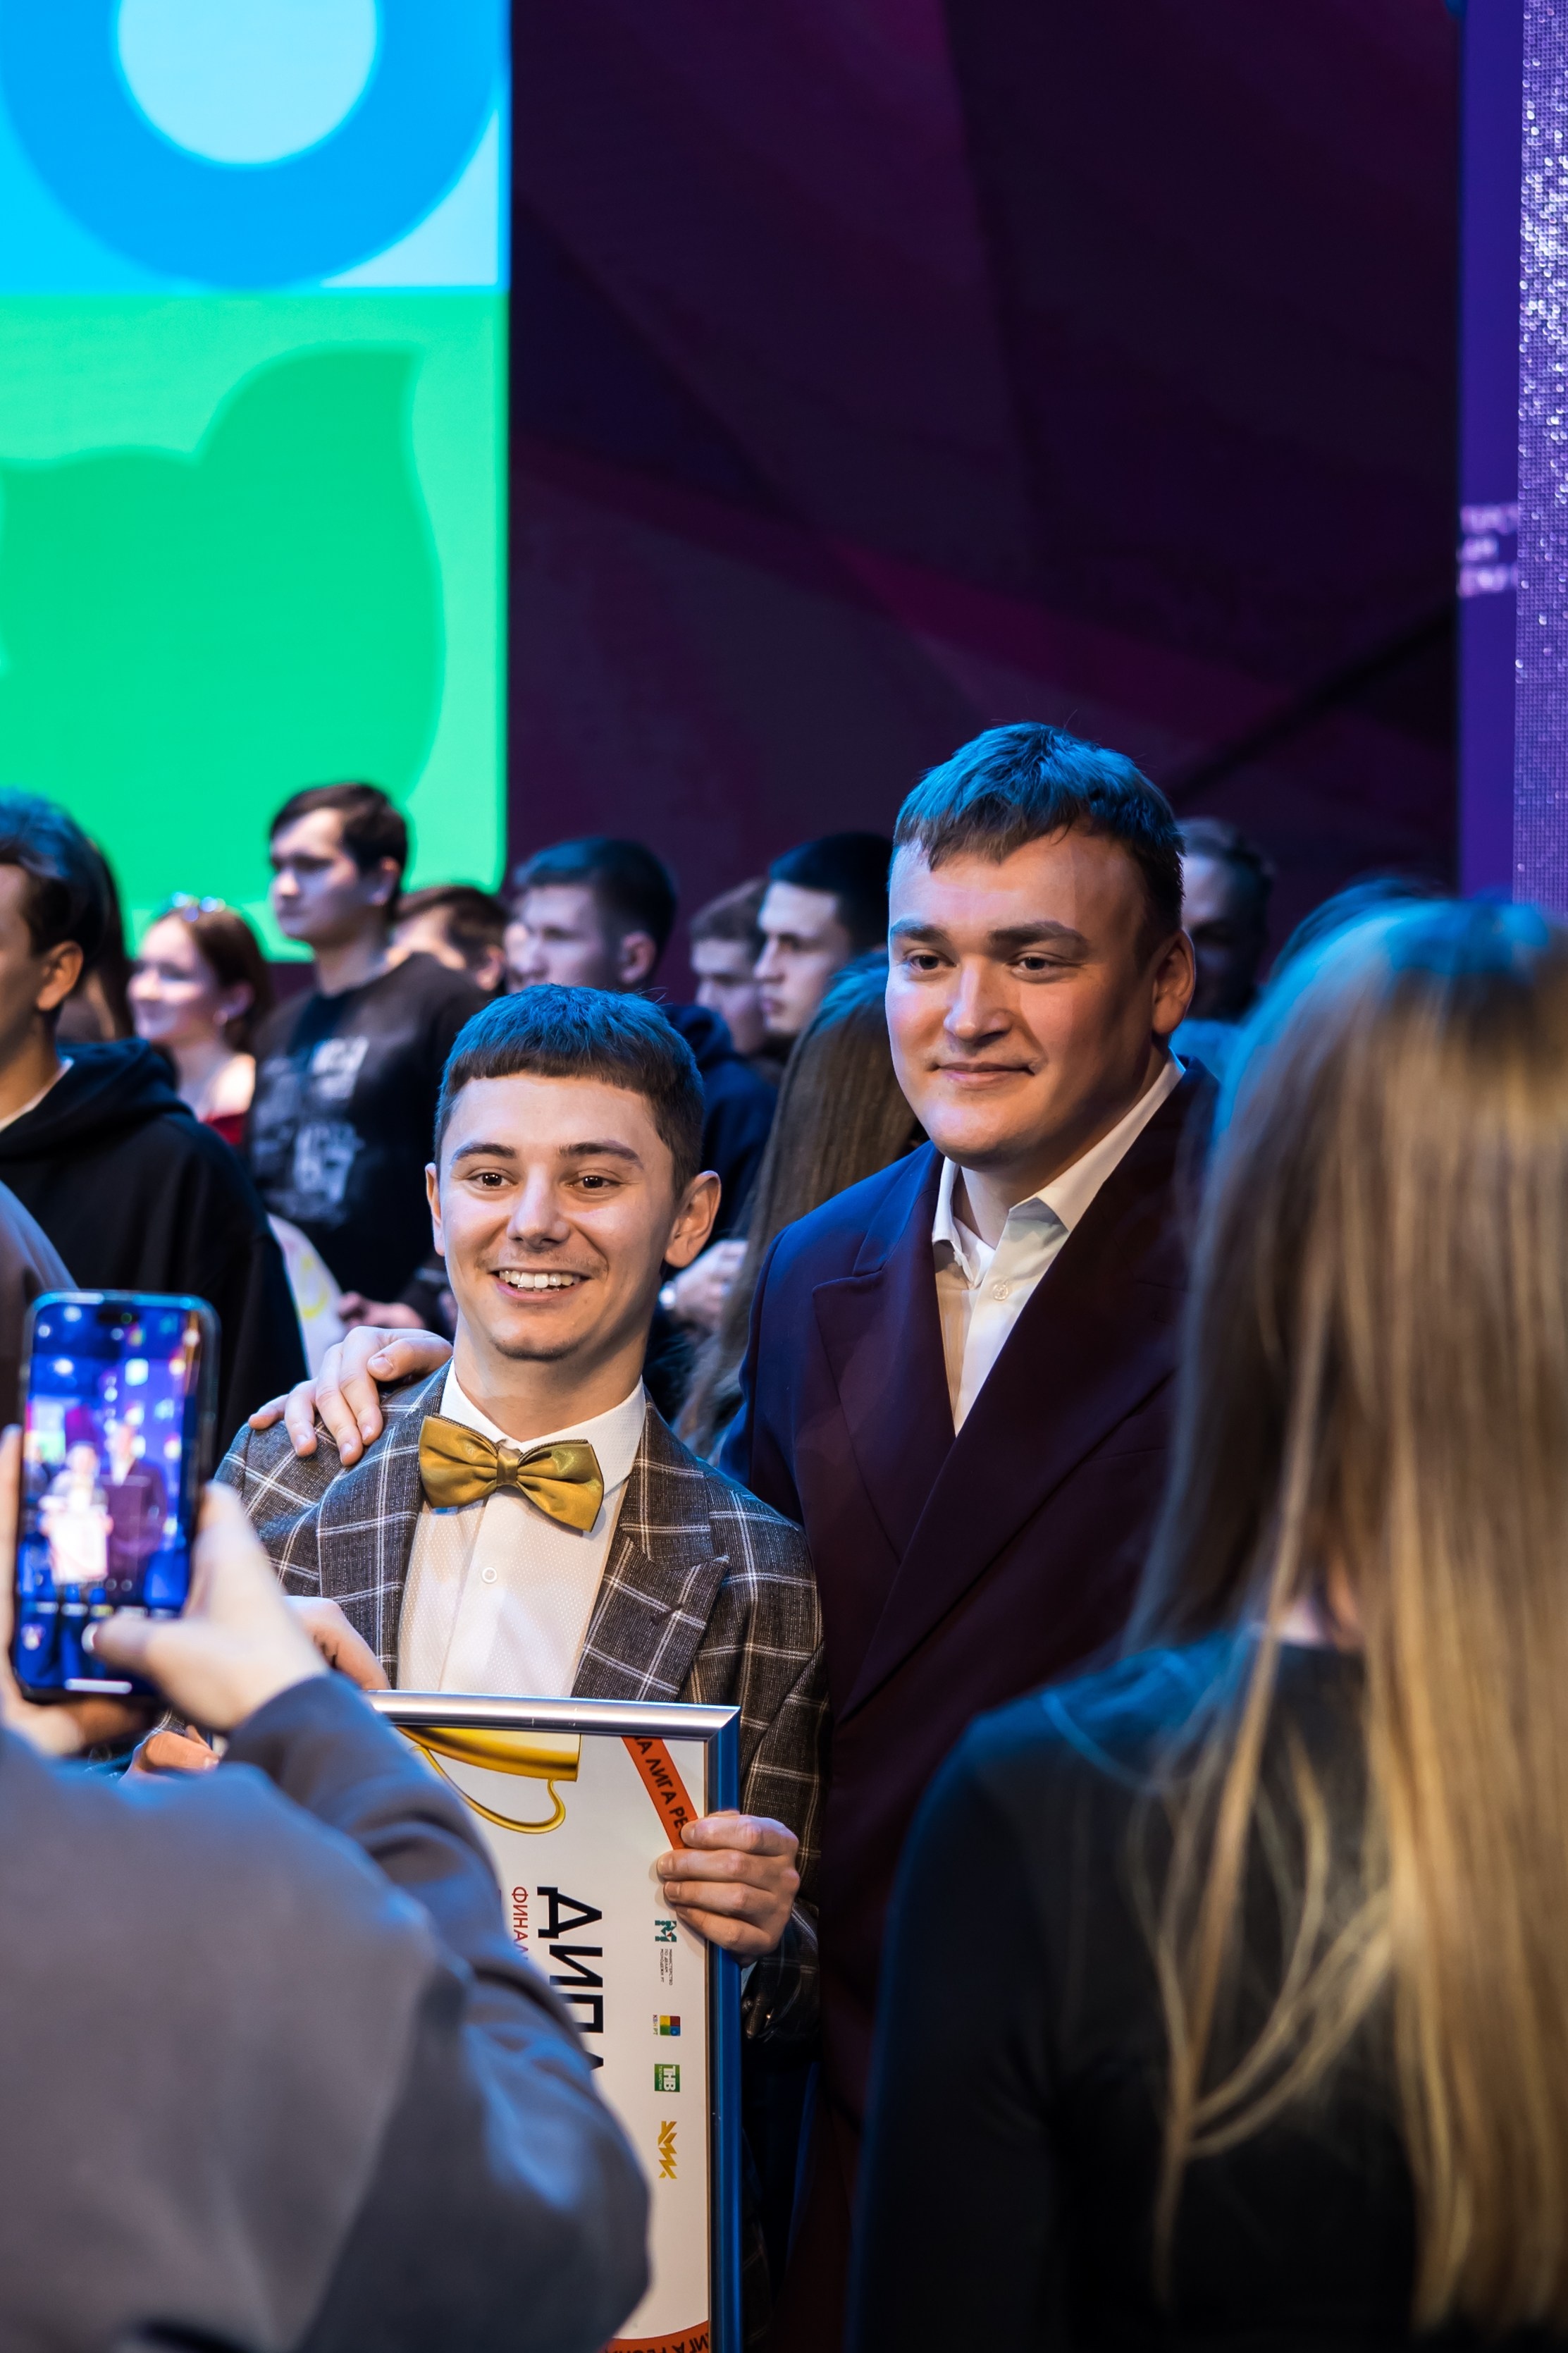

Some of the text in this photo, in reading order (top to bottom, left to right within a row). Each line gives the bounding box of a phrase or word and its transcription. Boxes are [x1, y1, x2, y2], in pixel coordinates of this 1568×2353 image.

[646, 1759, 677, 1805] ЛИГА
[537, 1886, 604, 2071] ДИП
[663, 2065, 676, 2091] ТНВ
[672, 2333, 709, 2353] ИГА
